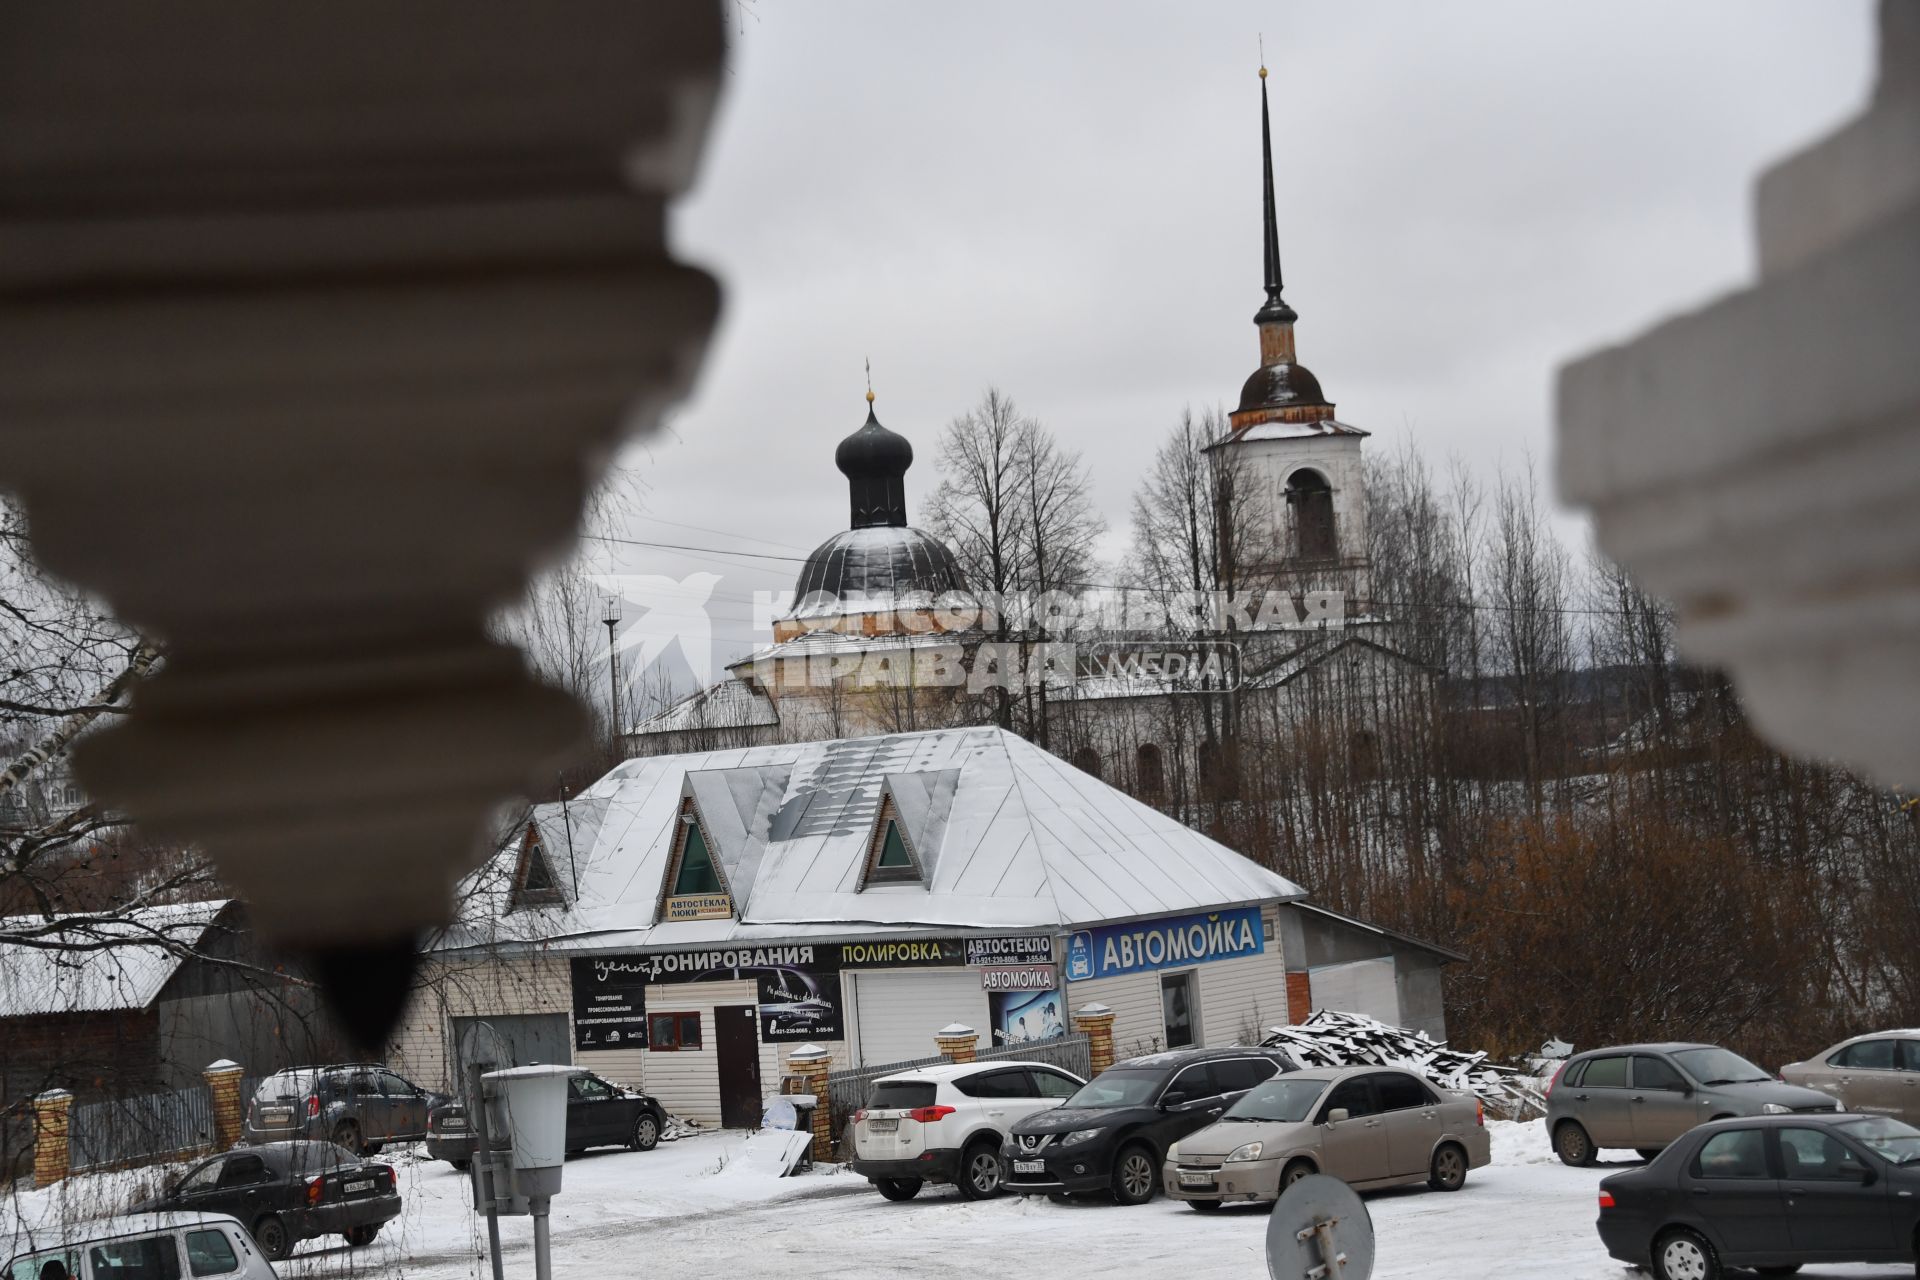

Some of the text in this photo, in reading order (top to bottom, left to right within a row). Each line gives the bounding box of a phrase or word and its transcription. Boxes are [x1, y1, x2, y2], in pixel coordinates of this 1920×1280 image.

[671, 908, 698, 918] ЛЮКИ
[842, 942, 943, 964] ПОЛИРОВКА
[967, 937, 1050, 955] АВТОСТЕКЛО
[1102, 914, 1256, 972] АВТОМОЙКА
[594, 945, 814, 982] центр ТОНИРОВАНИЯ
[983, 967, 1052, 989] АВТОМОЙКА
